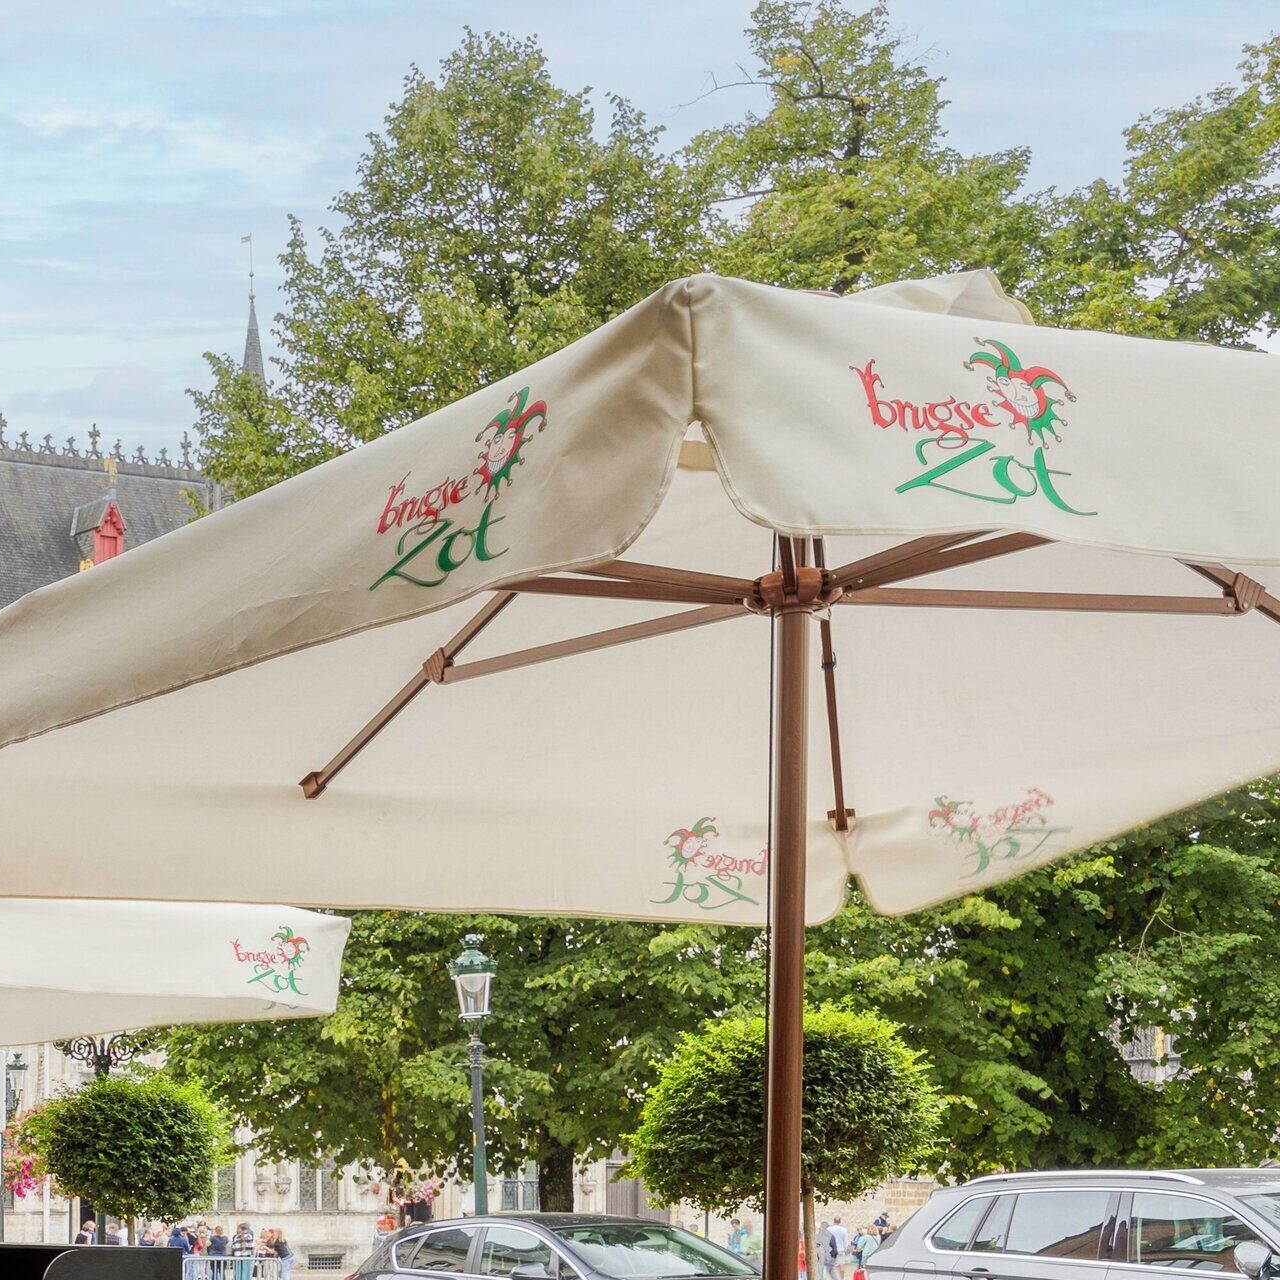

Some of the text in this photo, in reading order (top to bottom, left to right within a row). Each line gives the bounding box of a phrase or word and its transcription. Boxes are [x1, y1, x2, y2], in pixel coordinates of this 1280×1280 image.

[848, 358, 1002, 449] brugse
[376, 471, 471, 535] brugse
[894, 437, 1099, 516] Zot
[369, 499, 509, 591] Zot
[229, 938, 279, 970] brugse
[247, 963, 309, 996] Zot
